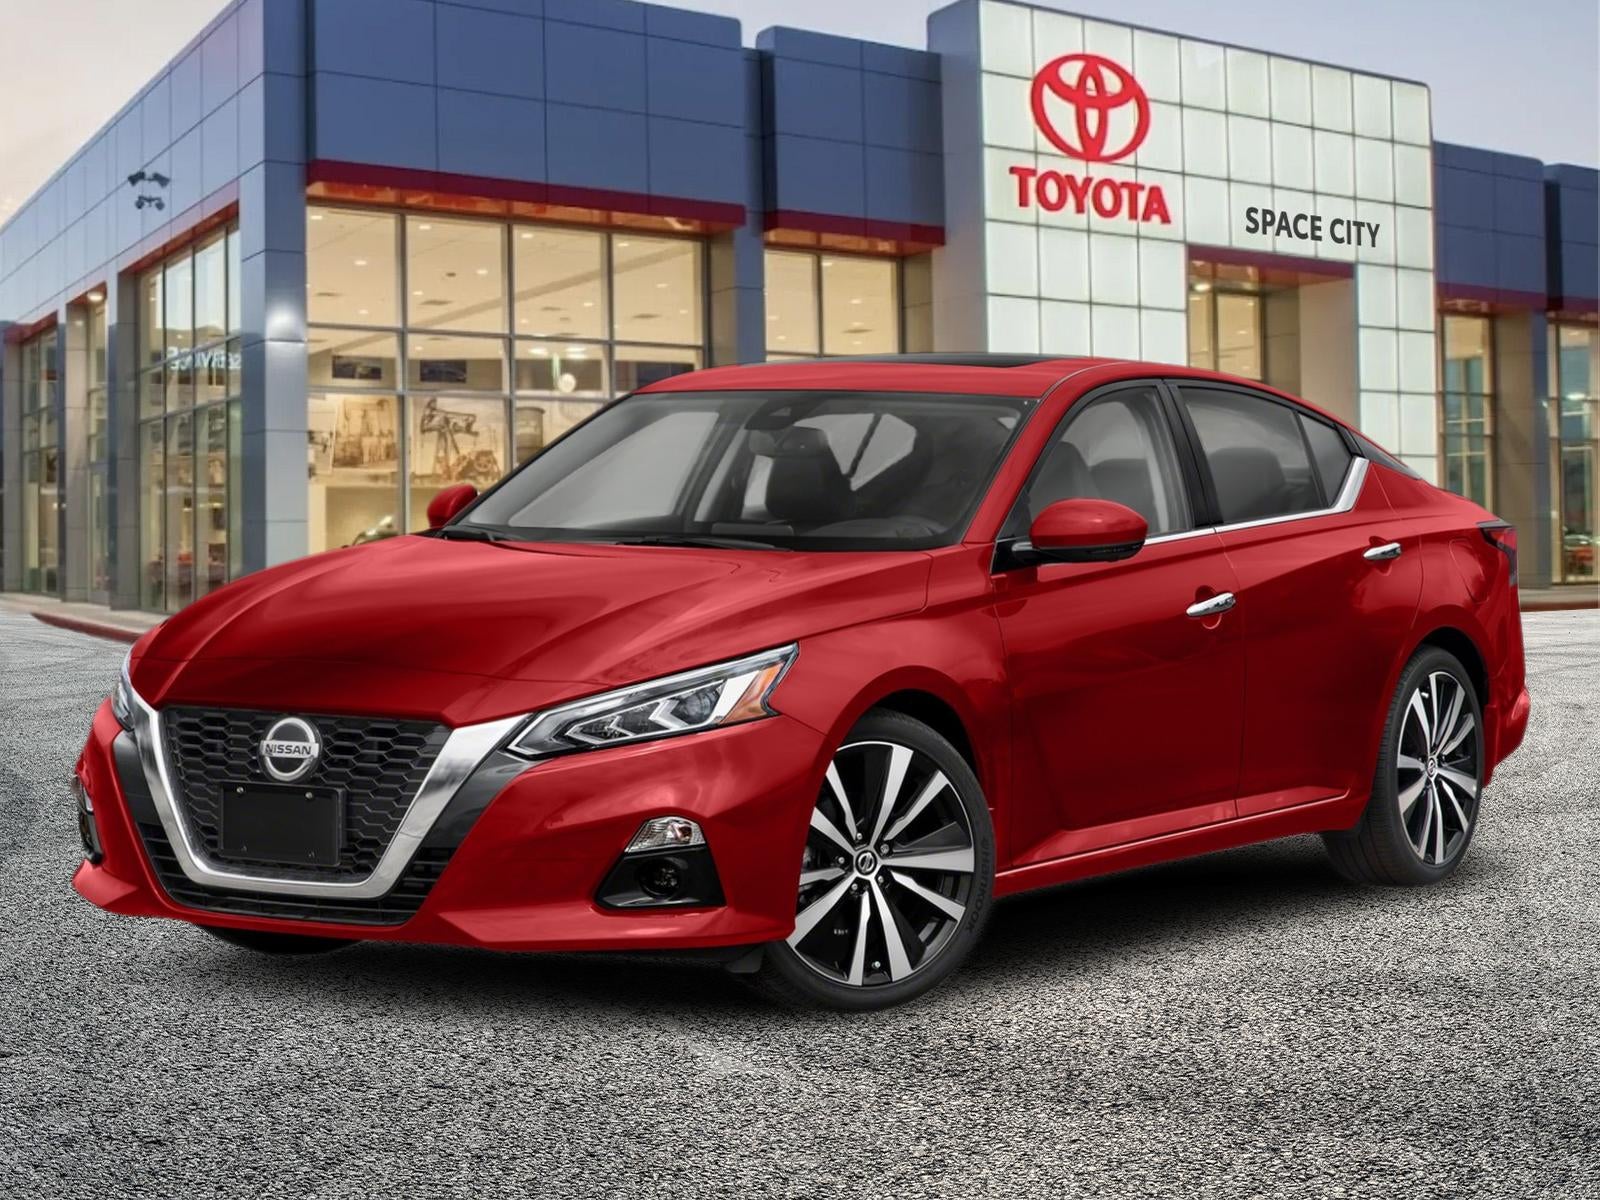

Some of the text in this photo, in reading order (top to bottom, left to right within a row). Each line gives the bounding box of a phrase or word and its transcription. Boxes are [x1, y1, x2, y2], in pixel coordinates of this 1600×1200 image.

[1009, 166, 1171, 224] TOYOTA
[1245, 207, 1381, 248] SPACE CITY
[265, 743, 312, 755] NISSAN
